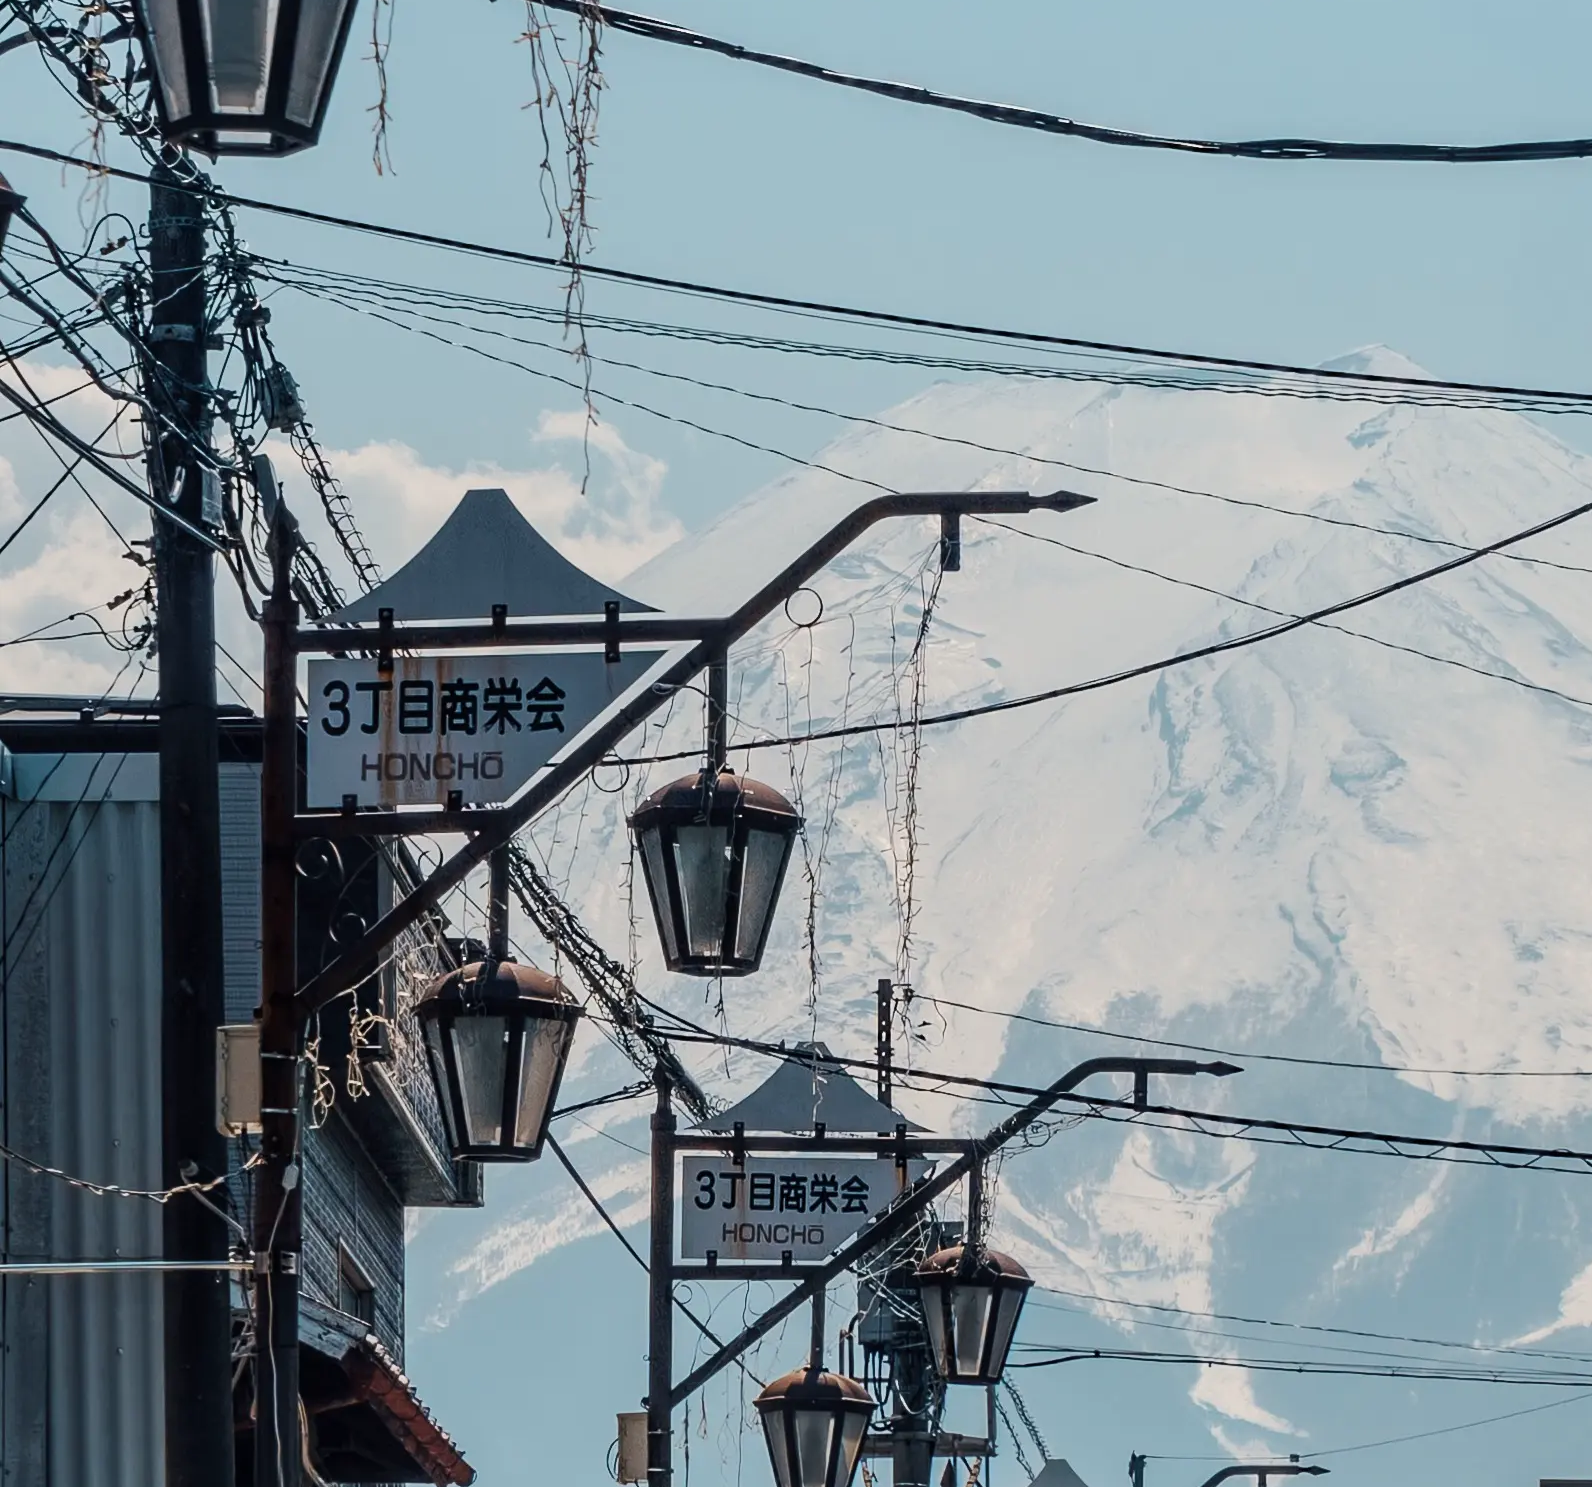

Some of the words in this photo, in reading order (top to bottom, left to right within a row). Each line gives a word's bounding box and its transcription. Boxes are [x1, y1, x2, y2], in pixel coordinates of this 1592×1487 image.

[321, 676, 567, 736] 3丁目商栄会
[693, 1171, 870, 1215] 3丁目商栄会
